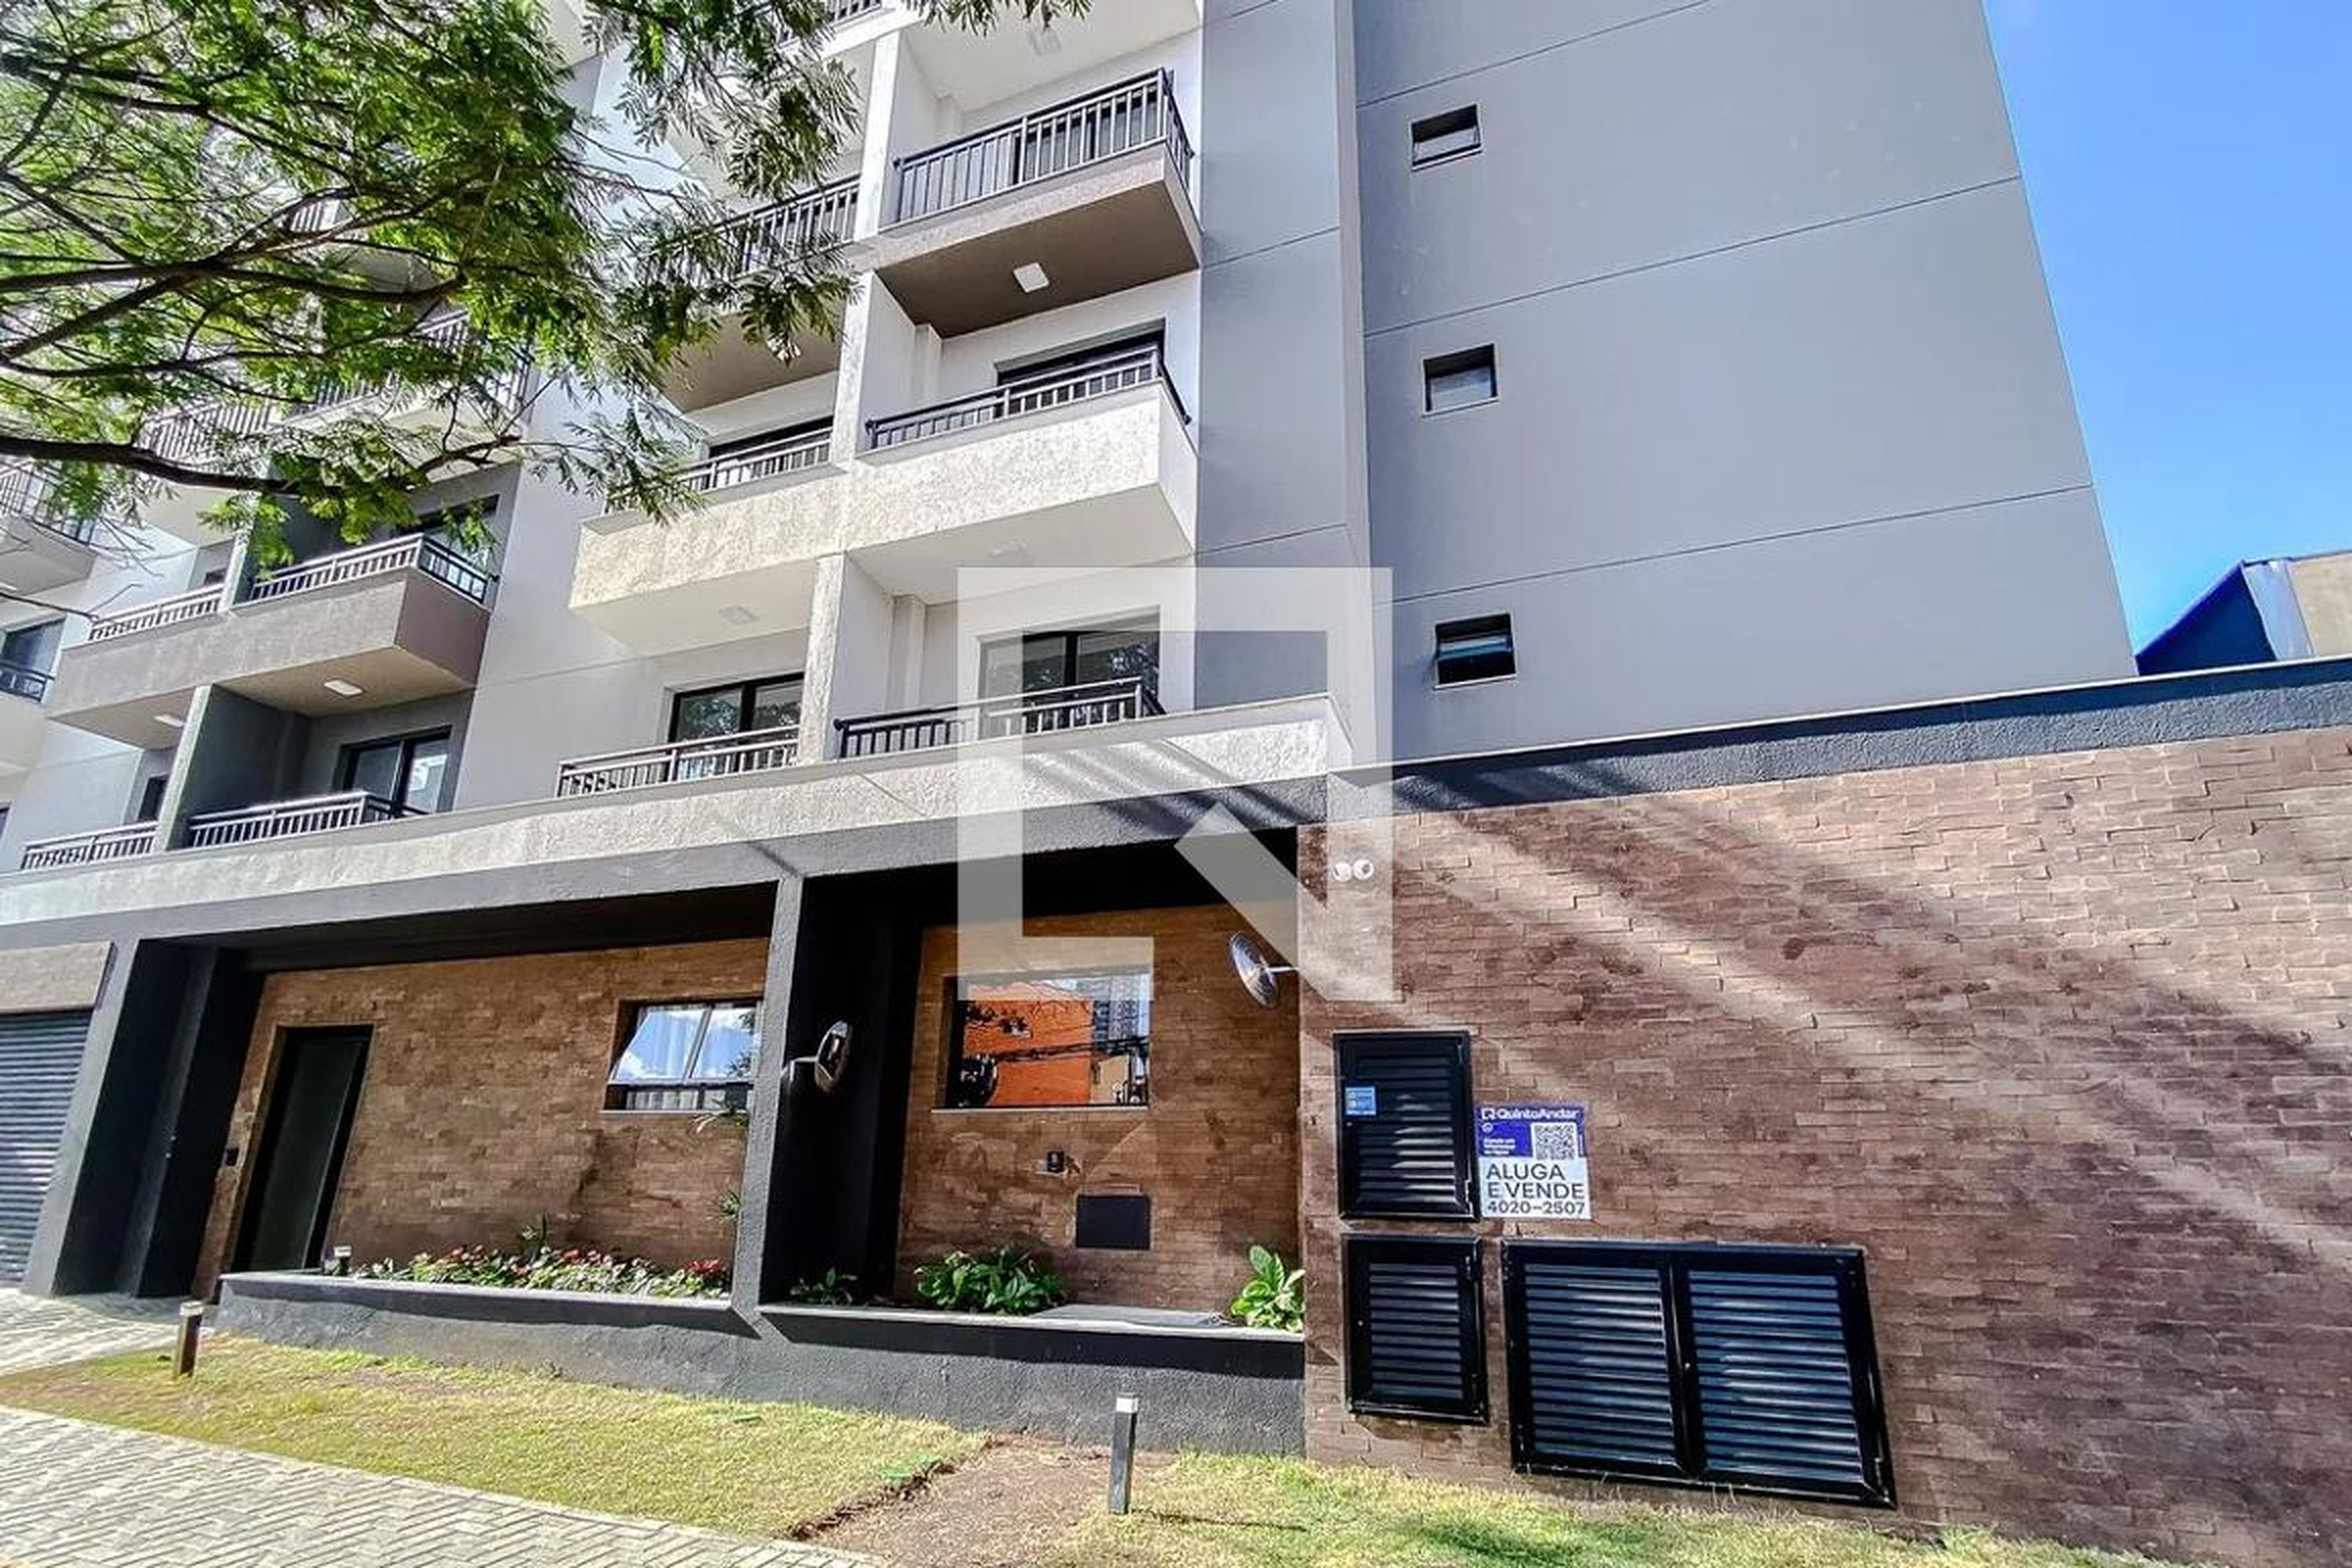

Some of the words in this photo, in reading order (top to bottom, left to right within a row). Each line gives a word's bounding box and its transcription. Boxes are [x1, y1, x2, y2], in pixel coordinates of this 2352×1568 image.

[1496, 1108, 1580, 1120] QuintoAndar
[1486, 1163, 1566, 1180] ALUGA
[1488, 1182, 1501, 1198] E
[1504, 1182, 1585, 1199] VENDE
